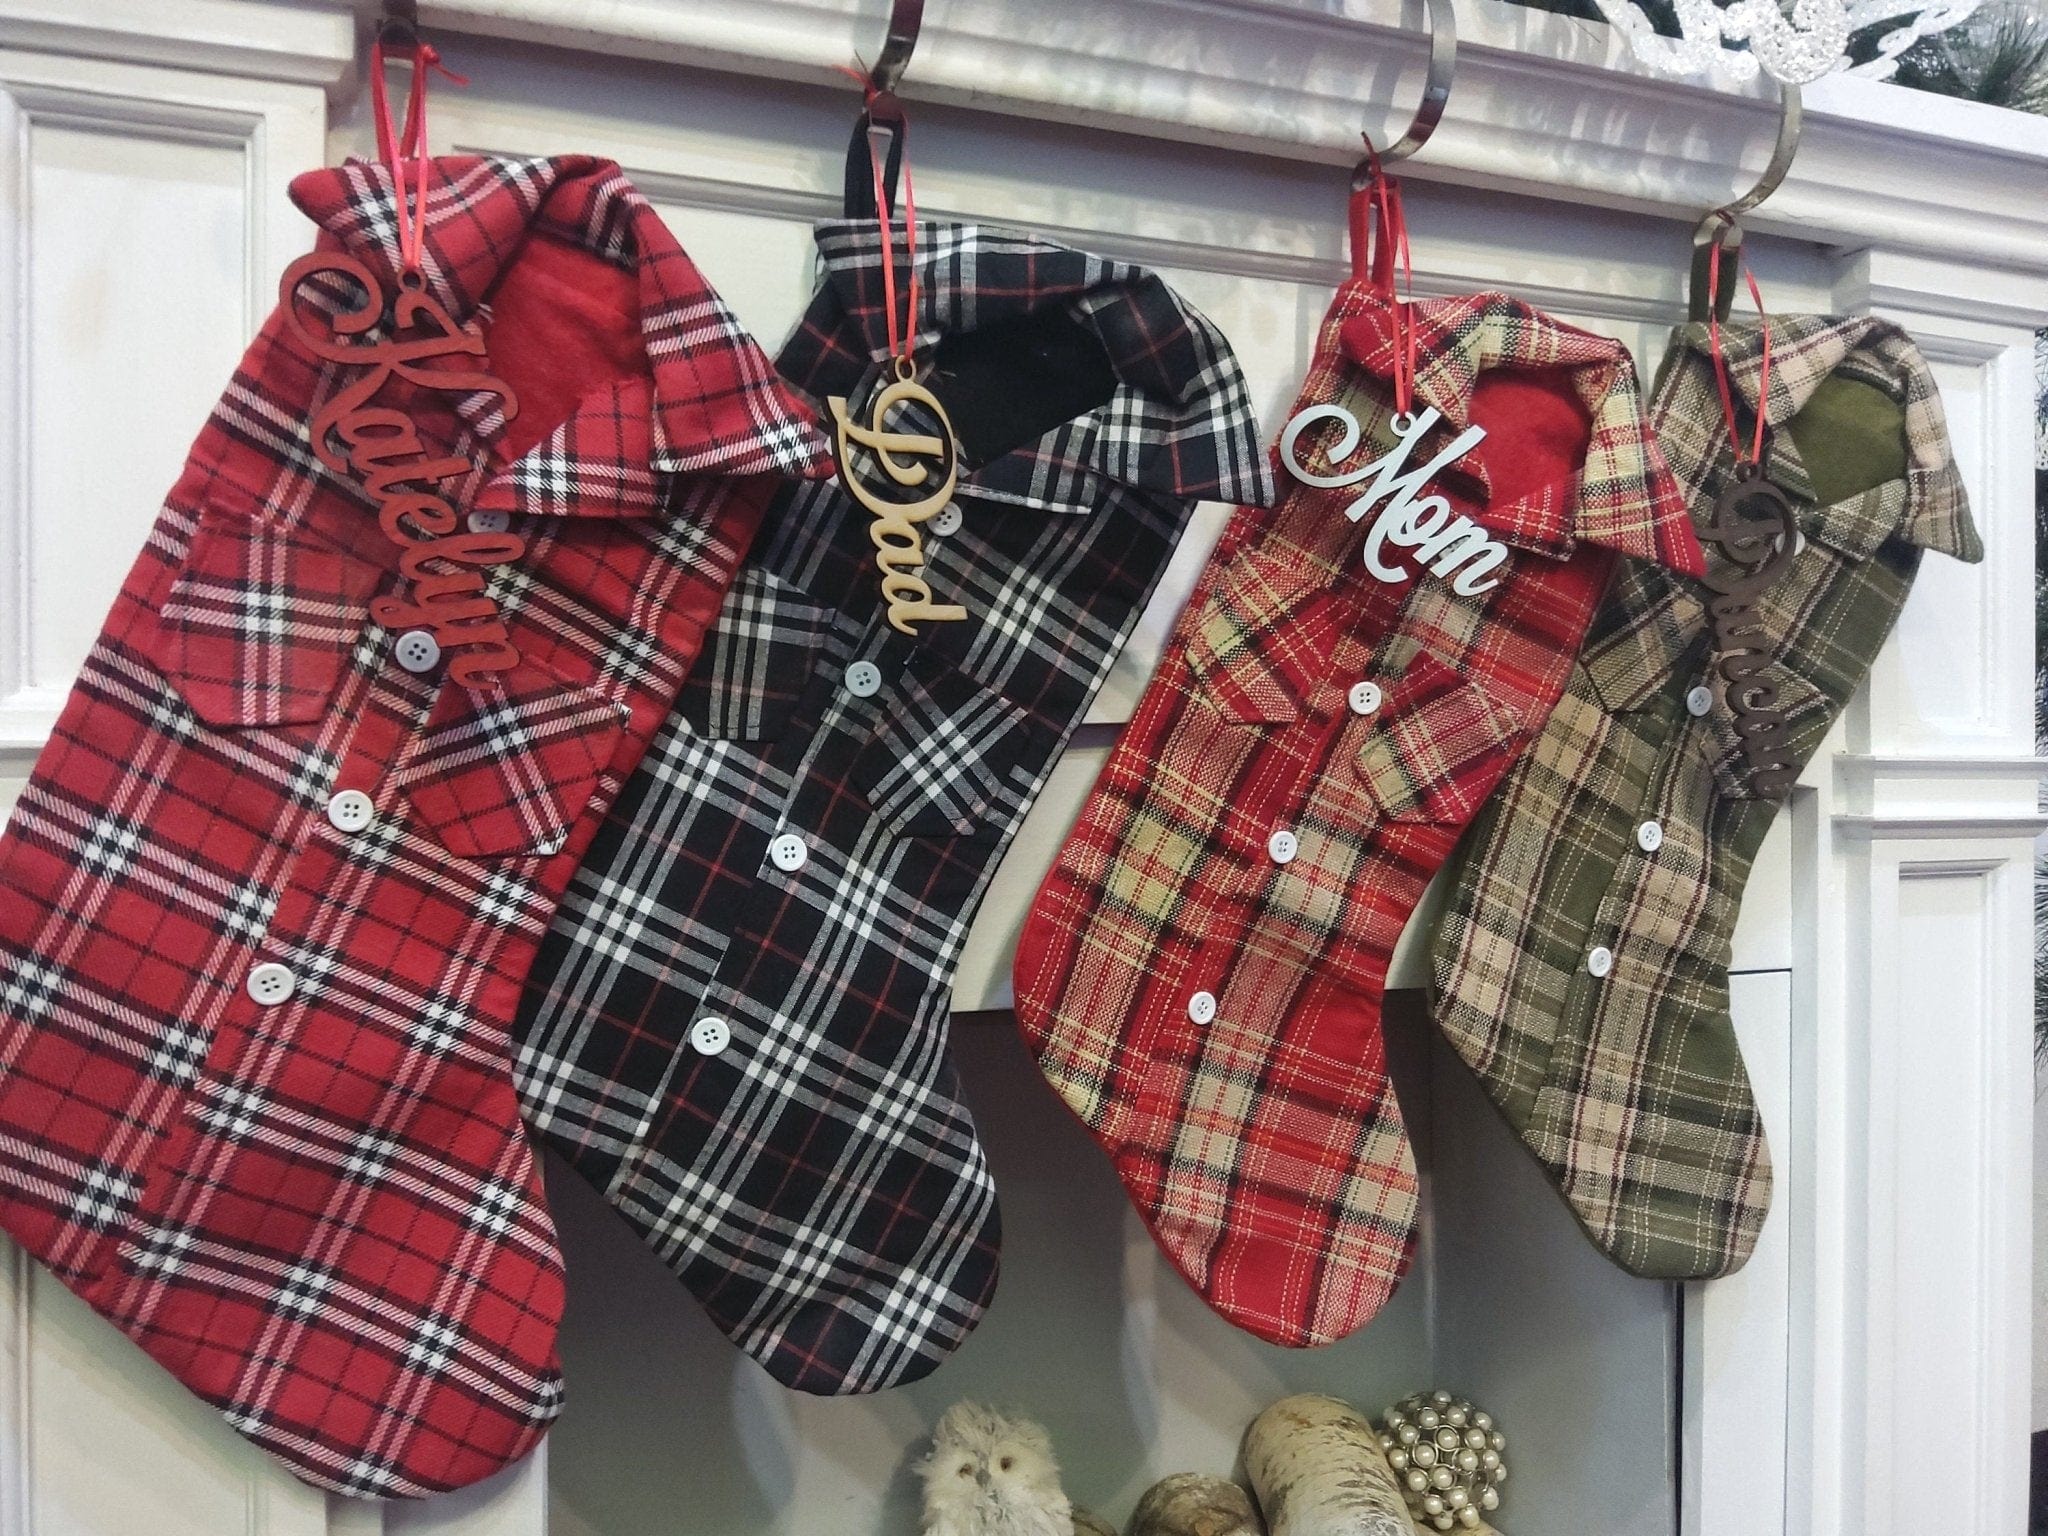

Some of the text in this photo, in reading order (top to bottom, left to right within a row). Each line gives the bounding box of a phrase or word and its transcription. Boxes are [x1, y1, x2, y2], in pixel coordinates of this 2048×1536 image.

[279, 251, 525, 690] Katelyn
[827, 381, 968, 636] Dad
[1280, 406, 1508, 596] Mom
[1695, 479, 1804, 800] Duncan
